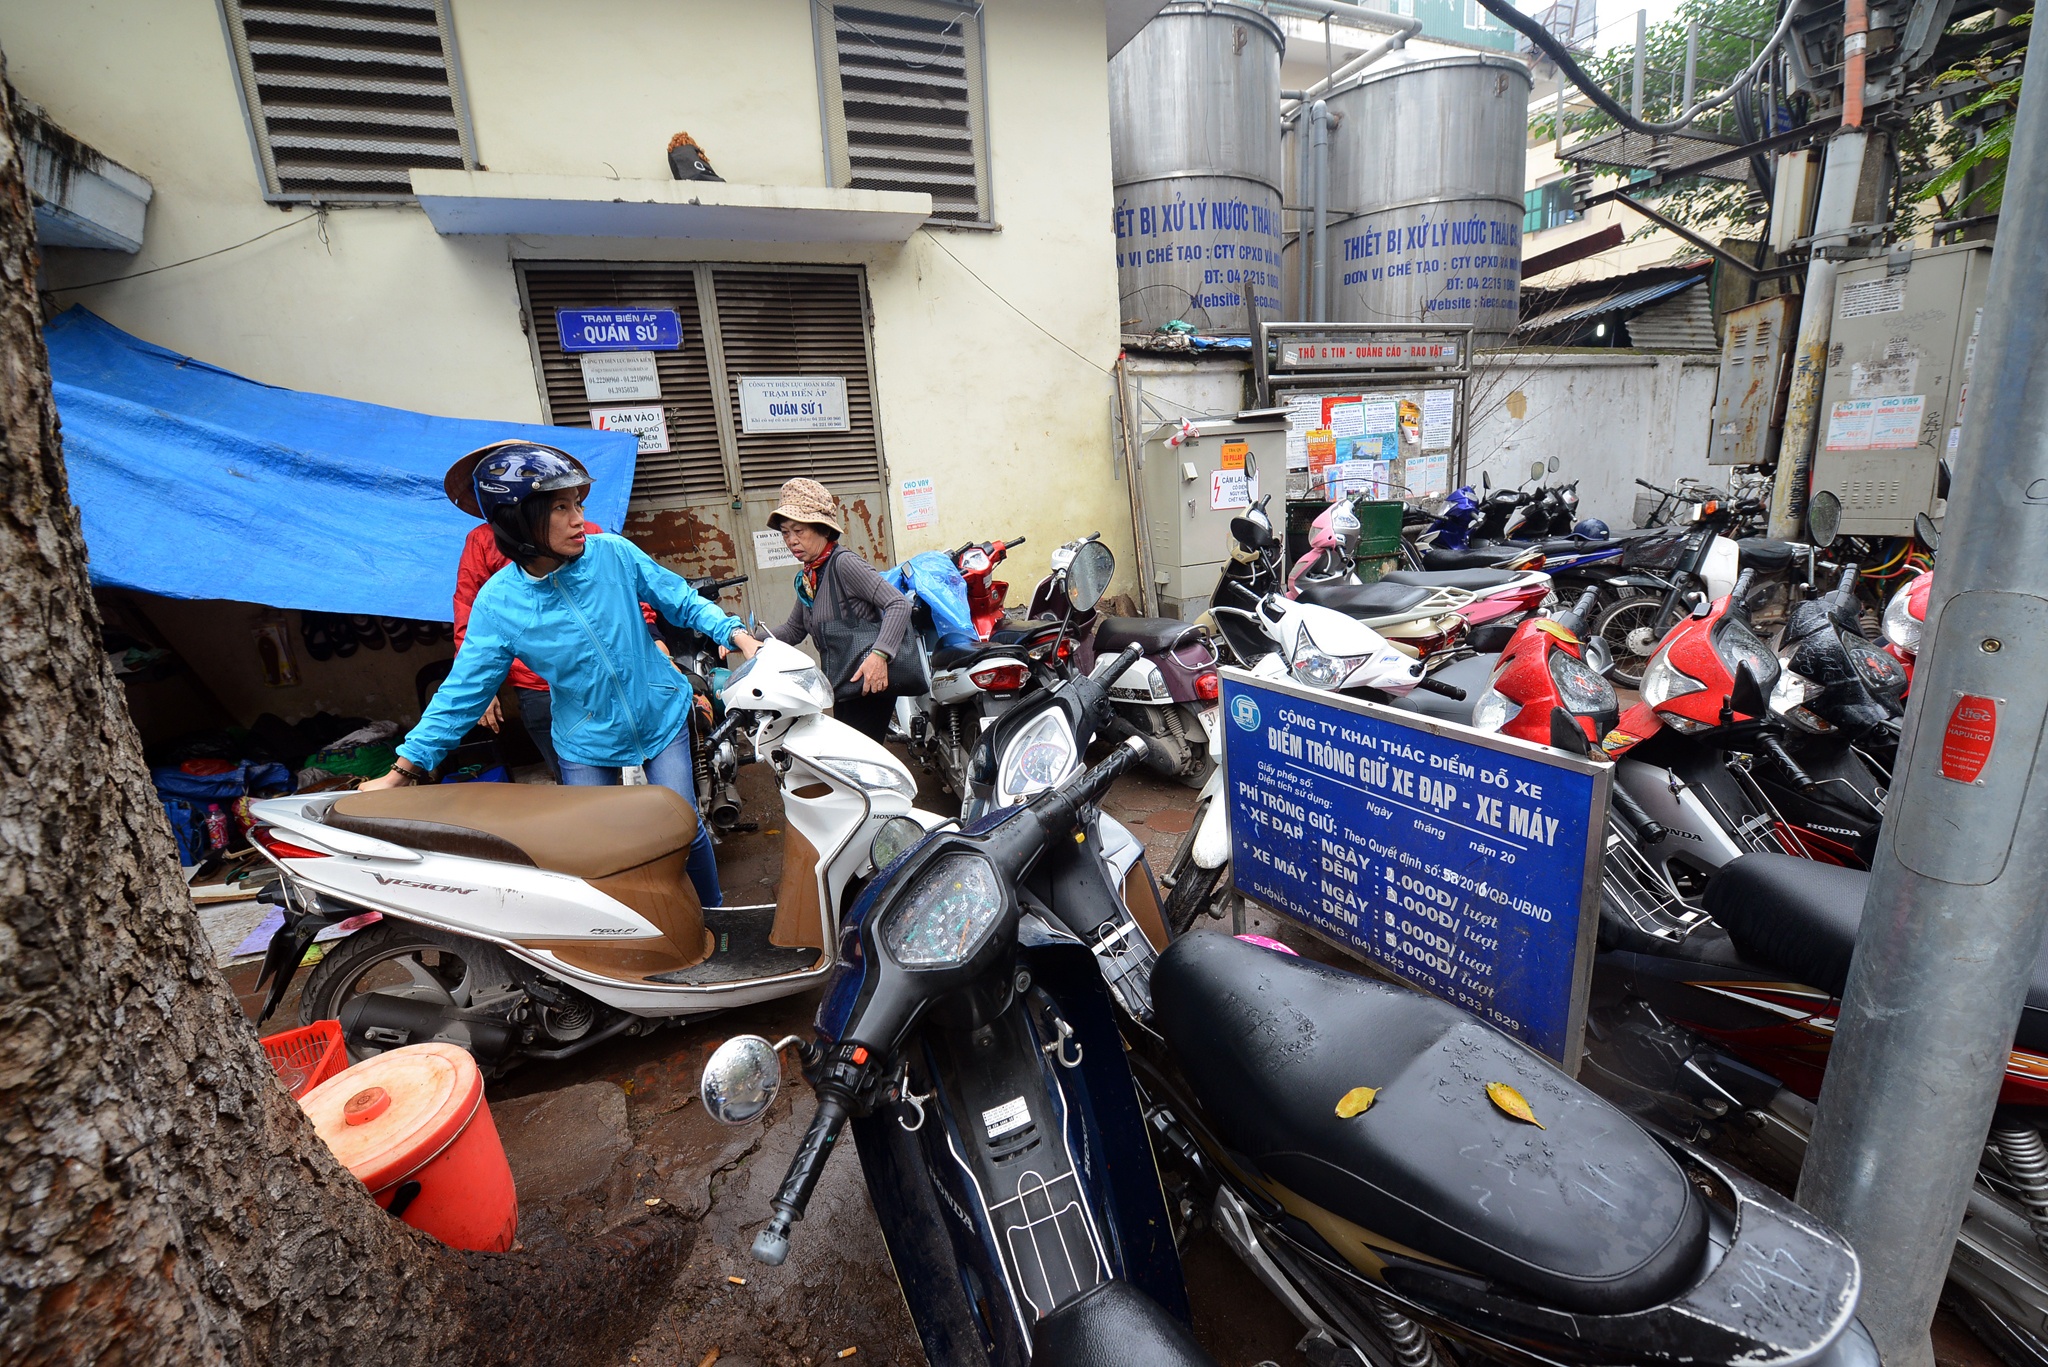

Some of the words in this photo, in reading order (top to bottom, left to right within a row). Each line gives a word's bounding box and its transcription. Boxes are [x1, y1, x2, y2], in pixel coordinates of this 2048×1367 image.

[1139, 205, 1157, 239] BỊ
[1161, 191, 1186, 233] XỬ
[1189, 197, 1208, 231] LÝ
[1211, 195, 1249, 232] NƯỚC
[1343, 224, 1382, 262] THIẾT
[1386, 228, 1402, 255] BỊ
[1406, 214, 1429, 250] XỬ
[1431, 218, 1449, 247] LÝ
[1451, 213, 1487, 246] NƯỚC
[1128, 250, 1142, 268] VỊ
[1145, 241, 1174, 265] CHẾ
[1176, 244, 1203, 264] TẠO
[1213, 244, 1236, 260] CTY
[1238, 245, 1264, 263] CPXD
[1204, 269, 1224, 285] ĐT:
[1226, 269, 1241, 284] 04
[1343, 268, 1368, 286] ĐƠN
[1372, 268, 1383, 282] VỊ
[1387, 258, 1413, 278] CHẾ
[1415, 259, 1440, 276] TẠO
[1451, 256, 1471, 270] CTY
[1474, 255, 1499, 269] CPXD
[1446, 278, 1464, 291] ĐT:
[1466, 277, 1480, 290] 04
[1481, 276, 1502, 290] 2215
[1190, 292, 1241, 309] Website
[1426, 297, 1471, 312] Website
[580, 314, 612, 324] TRẠM
[615, 312, 640, 323] BIẾN
[642, 313, 658, 322] ÁP
[583, 322, 631, 344] QUÁN
[635, 322, 659, 342] SỨ
[1330, 347, 1346, 358] TIN
[1355, 342, 1383, 359] QUẢNG
[1385, 343, 1402, 358] CÁO
[1410, 346, 1427, 357] RAO
[761, 390, 790, 399] TRẠM
[791, 387, 813, 397] BIẾN
[814, 388, 828, 397] ÁP
[1855, 401, 1872, 409] VAY
[1881, 398, 1900, 407] CHO
[1902, 397, 1920, 405] VAY
[633, 411, 655, 422] VÀO
[769, 400, 799, 417] QUÁN
[800, 399, 816, 415] SỨ
[903, 481, 917, 489] CHO
[917, 478, 930, 487] VAY
[1947, 727, 1991, 742] HAPULICO
[1278, 709, 1316, 731] CÔNG
[1319, 720, 1338, 737] TY
[1341, 727, 1377, 750] KHAI
[1380, 739, 1426, 764] THÁC
[1429, 753, 1475, 780] ĐIỂM
[1479, 767, 1510, 789] ĐỖ
[1514, 779, 1543, 801] XE
[1257, 772, 1277, 787] Diện
[1277, 780, 1294, 794] tích
[1294, 786, 1308, 798] sử
[1307, 791, 1334, 810] dụng:
[1267, 724, 1303, 761] ĐIỂM
[1305, 738, 1355, 778] TRÔNG
[1359, 755, 1390, 789] GIỮ
[1391, 766, 1415, 799] XE
[1418, 775, 1457, 814] ĐẠP
[1475, 793, 1503, 829] XE
[1508, 807, 1560, 848] MÁY
[1257, 760, 1276, 776] Giấy
[1276, 768, 1299, 786] phép
[1299, 777, 1315, 789] số:
[1365, 800, 1394, 821] Ngày
[1413, 819, 1447, 841] tháng
[1468, 840, 1497, 858] năm
[1499, 850, 1517, 865] 20
[1238, 781, 1259, 802] PHÍ
[1260, 790, 1306, 823] TRÔNG
[1308, 811, 1338, 836] GIỮ:
[1343, 827, 1367, 847] Theo
[1367, 838, 1398, 861] Quyết
[1398, 852, 1422, 872] định
[1662, 826, 1704, 843] ONDA
[1806, 821, 1862, 838] HONDA
[1250, 806, 1269, 826] XE
[1271, 816, 1304, 841] ĐẠP
[1321, 838, 1371, 871] NGÀY
[1462, 902, 1499, 930] lượt
[360, 868, 479, 896] VISION
[1252, 845, 1271, 866] XE
[1273, 856, 1308, 884] MÁY
[1321, 879, 1369, 913] NGÀY
[1457, 949, 1493, 977] lượt
[1321, 856, 1358, 886] ĐÊM
[1463, 924, 1499, 951] lượt
[1321, 898, 1358, 928] ĐÊM
[1253, 882, 1288, 907] ĐƯỜNG
[1289, 901, 1311, 919] DÂY
[1313, 913, 1349, 940] NÓNG:
[1351, 934, 1372, 953] (04)
[1374, 946, 1382, 957] 3
[1383, 952, 1405, 970] 825
[1407, 964, 1436, 986] 6779
[1447, 986, 1456, 997] 3
[1458, 991, 1484, 1012] 933
[1486, 1006, 1521, 1032] 1629
[928, 1165, 976, 1236] HONDA
